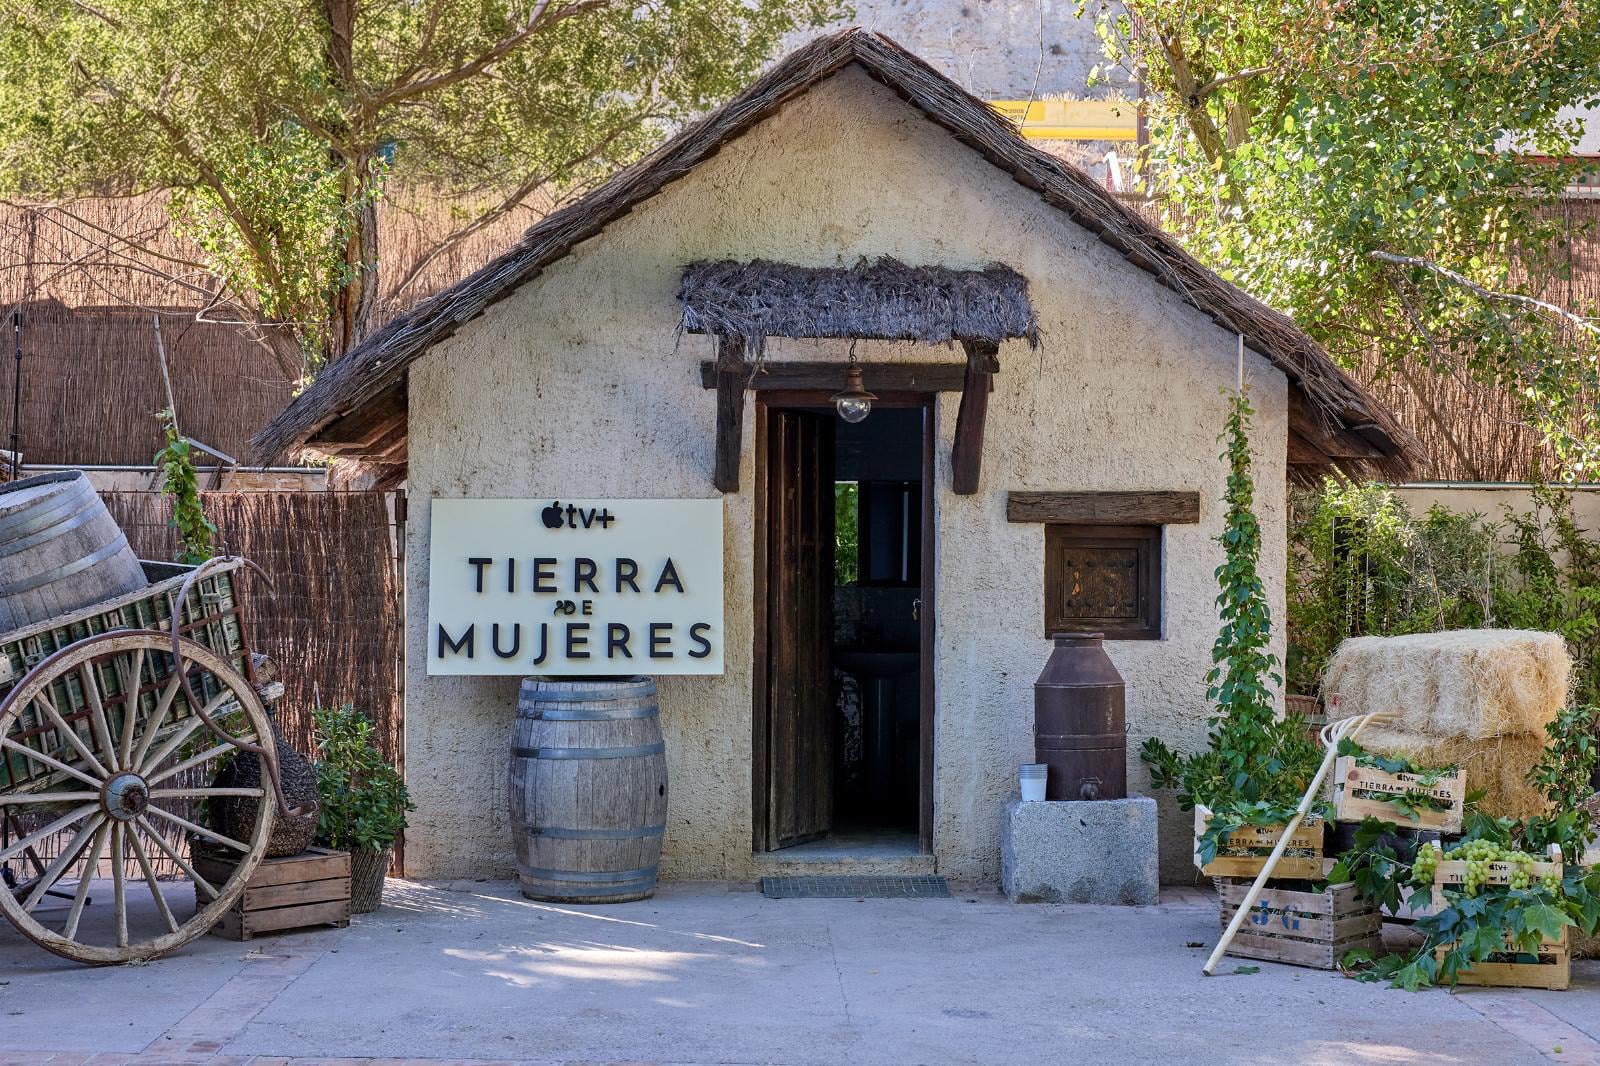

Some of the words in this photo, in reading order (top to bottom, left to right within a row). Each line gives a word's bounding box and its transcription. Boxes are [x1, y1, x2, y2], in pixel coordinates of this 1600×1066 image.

[468, 557, 685, 594] TIERRA
[554, 600, 593, 616] DE
[438, 622, 712, 666] MUJERES
[1360, 781, 1394, 792] TIERRA
[1229, 838, 1254, 846] ERRA
